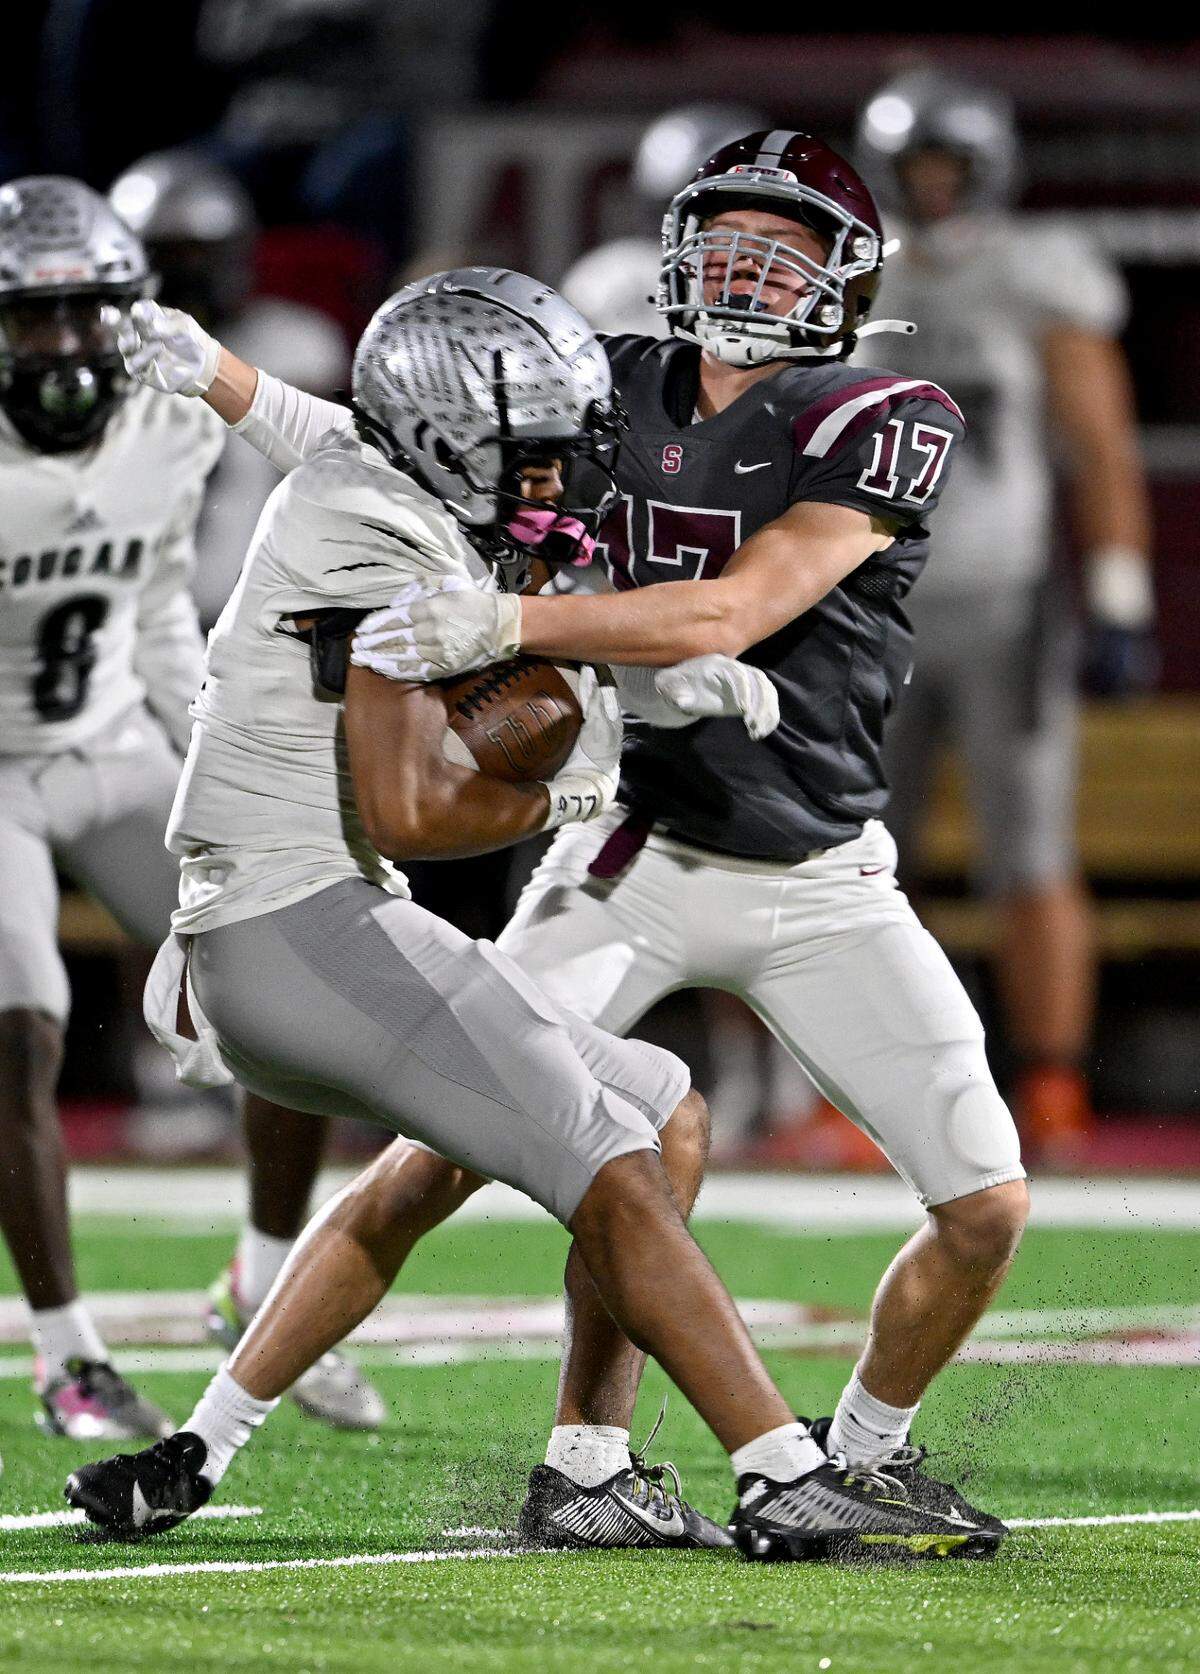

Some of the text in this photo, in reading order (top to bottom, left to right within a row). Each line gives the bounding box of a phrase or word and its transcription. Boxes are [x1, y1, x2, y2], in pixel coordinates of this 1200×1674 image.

[661, 443, 684, 474] S
[857, 418, 954, 505] 17
[592, 490, 742, 592] 17
[33, 592, 110, 723] 8
